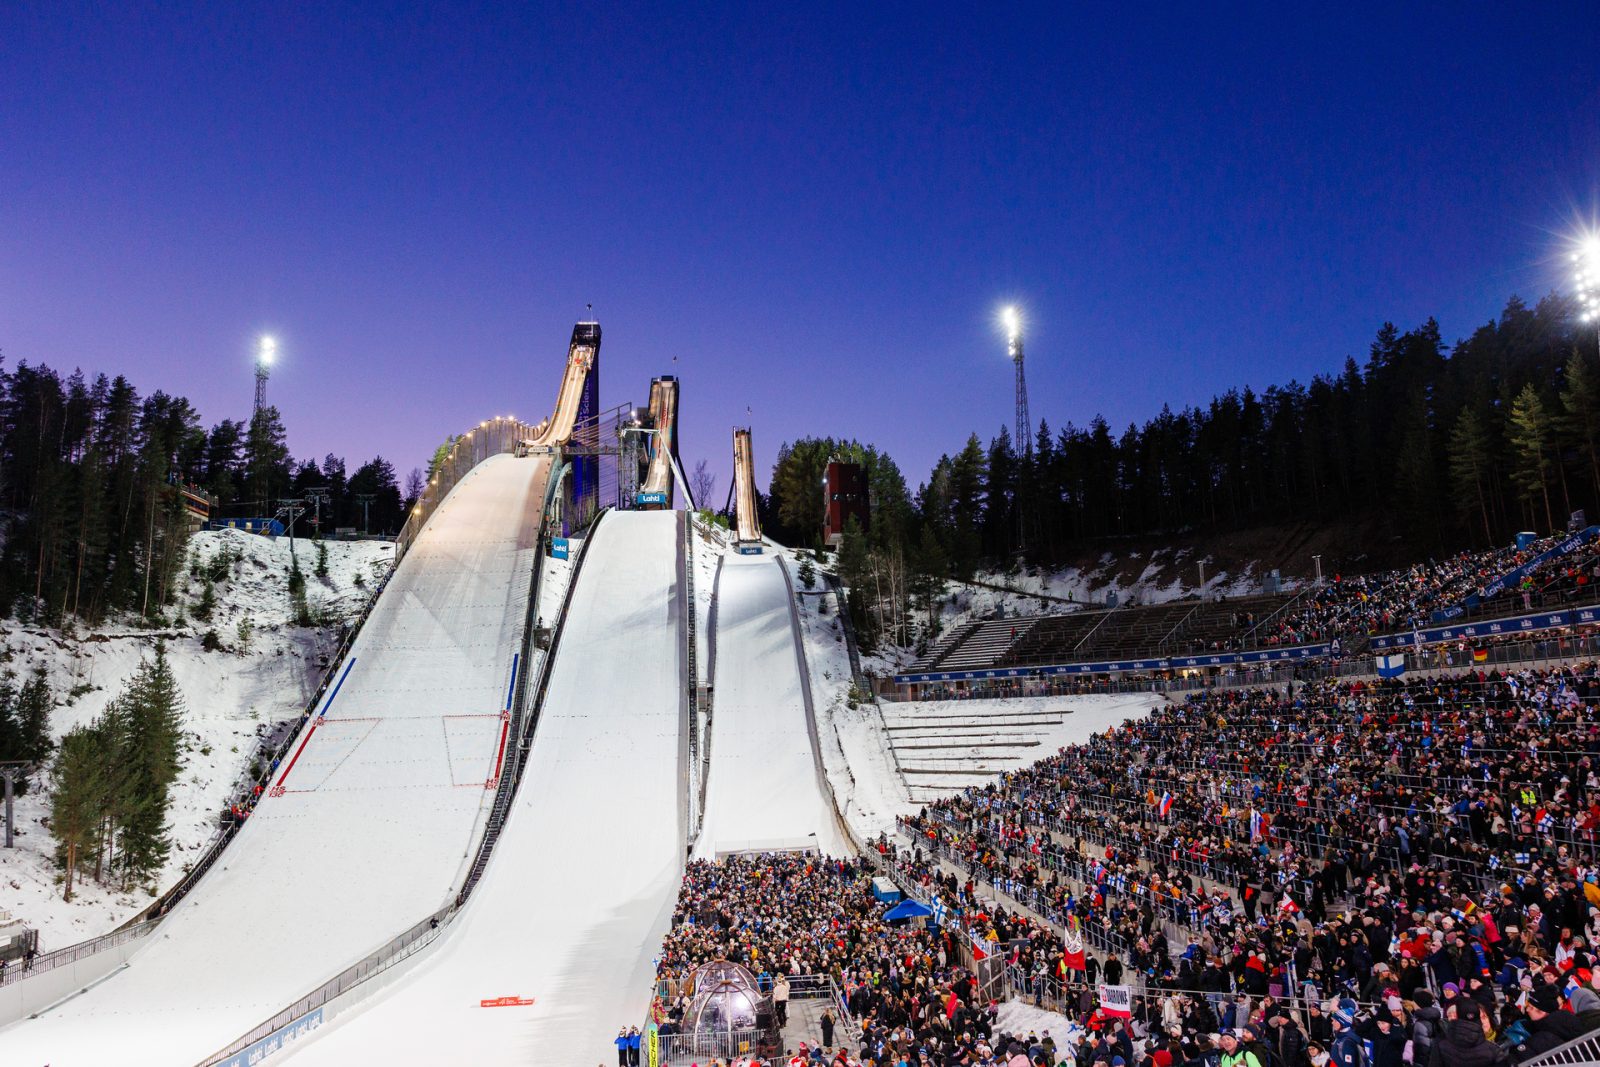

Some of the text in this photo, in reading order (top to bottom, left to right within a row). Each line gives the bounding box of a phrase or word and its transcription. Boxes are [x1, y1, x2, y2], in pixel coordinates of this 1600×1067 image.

[1561, 536, 1583, 553] Lahti
[1332, 640, 1340, 648] A
[248, 1046, 263, 1066] Lahti
